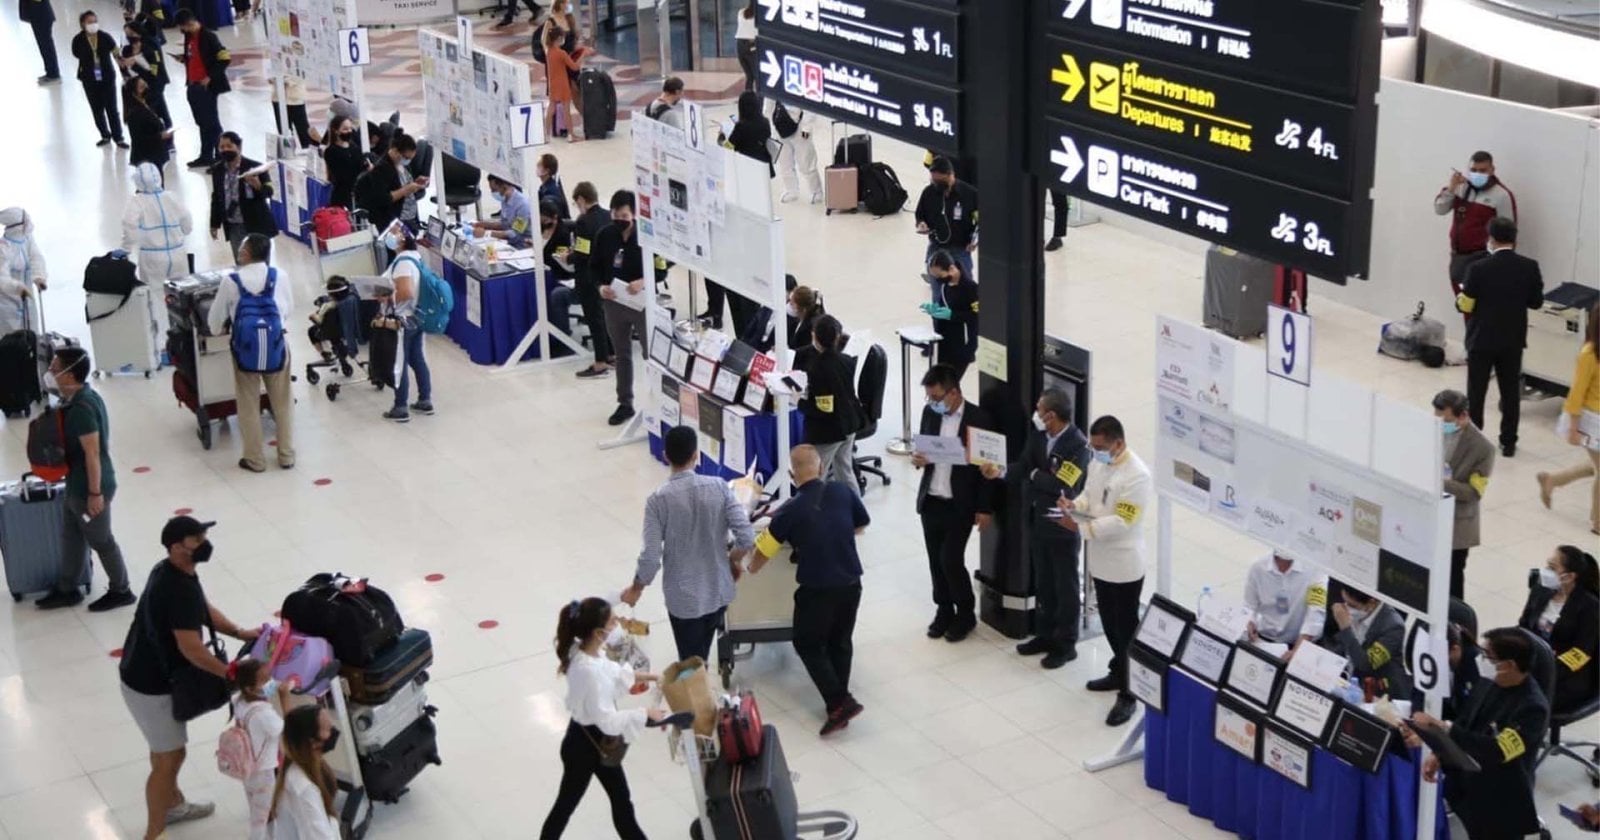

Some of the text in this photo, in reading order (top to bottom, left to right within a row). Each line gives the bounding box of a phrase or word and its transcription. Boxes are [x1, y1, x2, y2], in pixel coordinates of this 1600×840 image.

[411, 0, 437, 8] SERVICE
[1126, 14, 1192, 46] Information
[348, 30, 360, 64] 6
[520, 106, 531, 144] 7
[690, 104, 698, 148] 8
[1121, 101, 1185, 134] Departures
[1121, 184, 1170, 215] Car Park
[1281, 312, 1296, 375] 9
[1117, 503, 1137, 516] OTEL
[1193, 636, 1226, 658] NOVOTEL
[1419, 652, 1439, 690] 9
[1288, 683, 1330, 707] NOVOTEL
